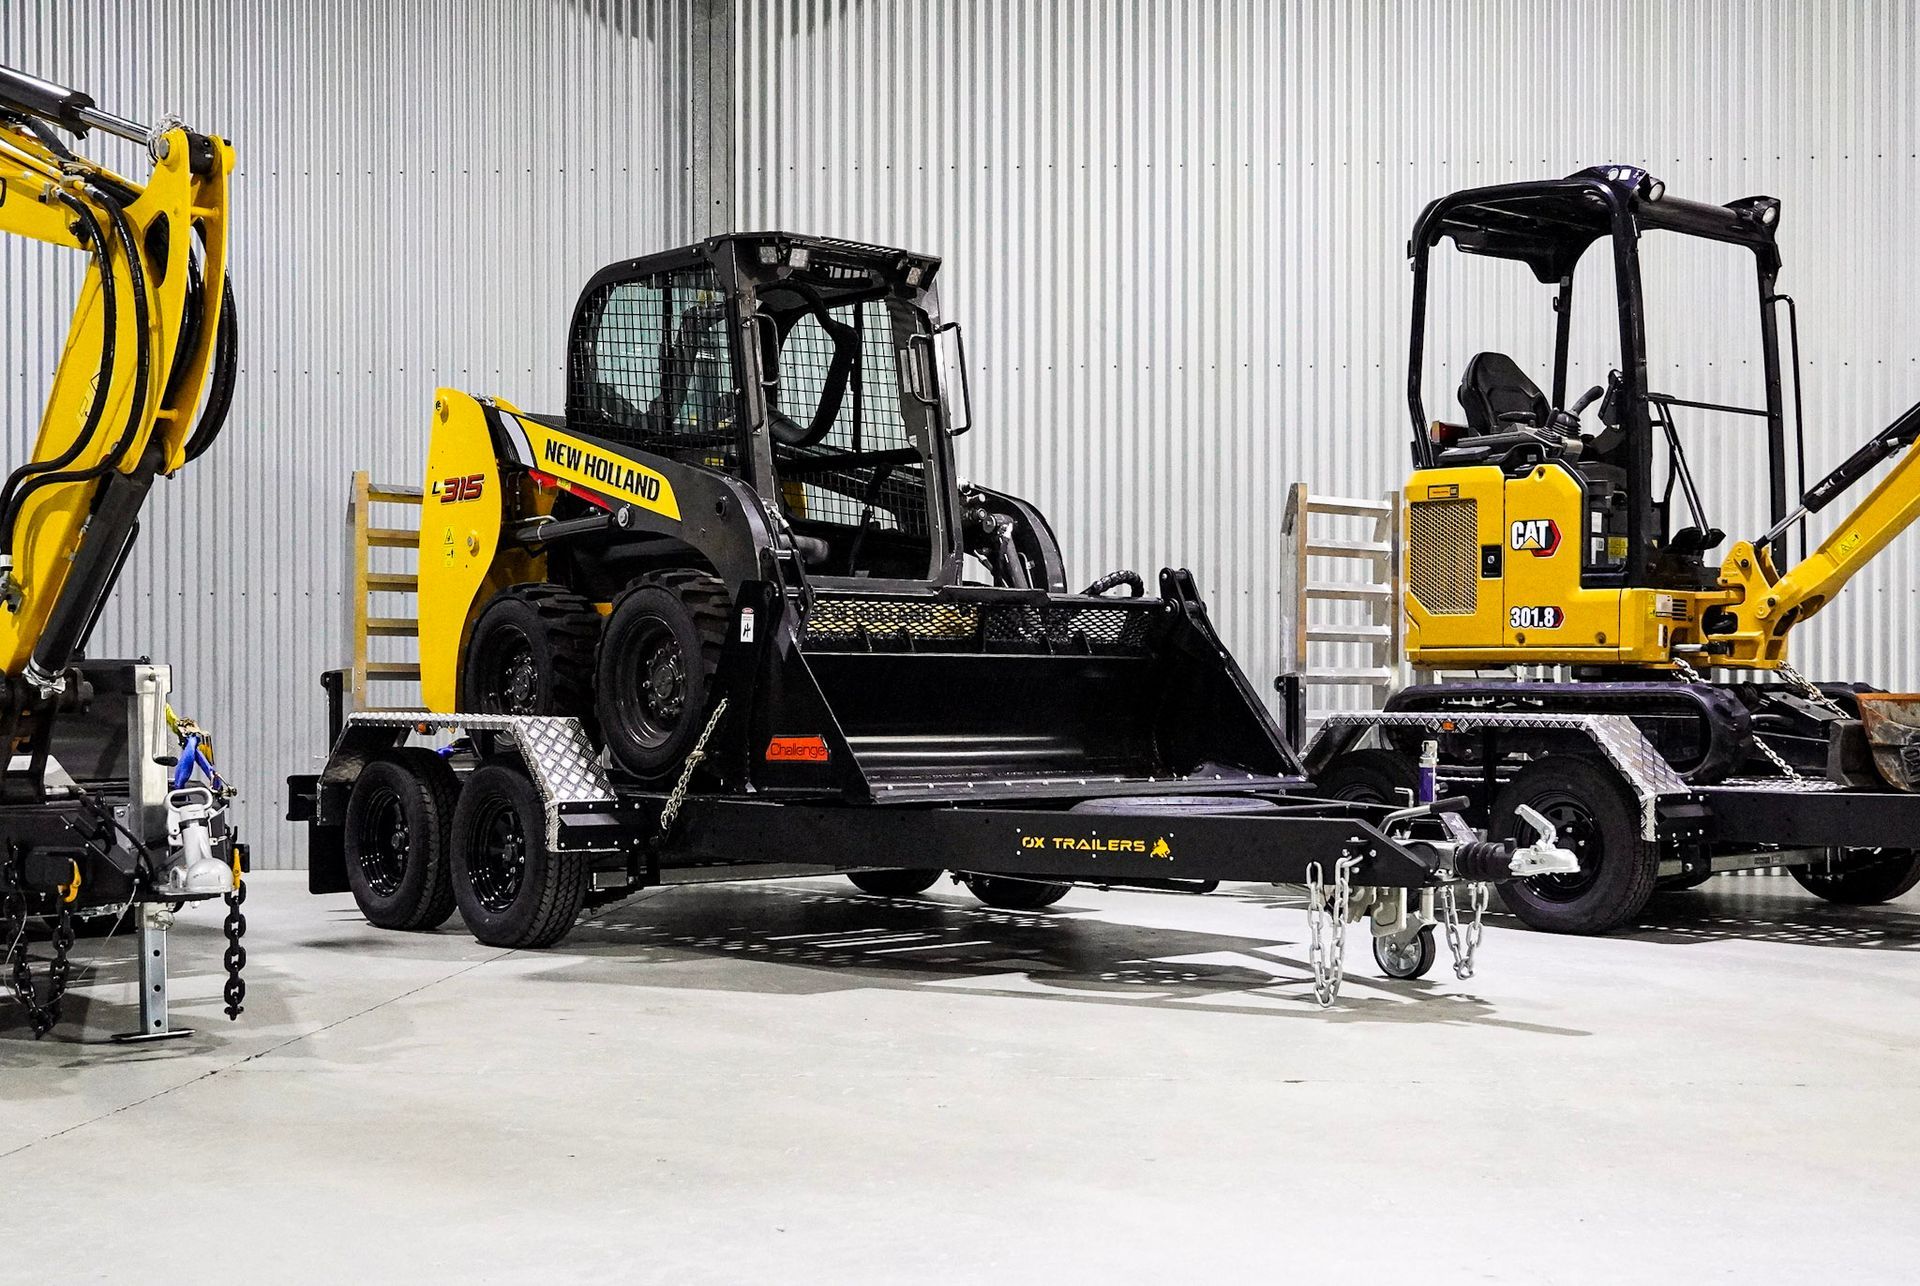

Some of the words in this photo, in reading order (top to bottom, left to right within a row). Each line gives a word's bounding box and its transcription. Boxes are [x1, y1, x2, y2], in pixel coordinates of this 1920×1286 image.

[544, 438, 582, 472] NEW
[583, 453, 660, 502] HOLLAND
[1511, 520, 1549, 550] CAT
[1510, 606, 1555, 628] 301.8
[770, 742, 825, 759] Challenge
[1022, 836, 1045, 849] OX
[1052, 837, 1146, 852] TRAILERS
